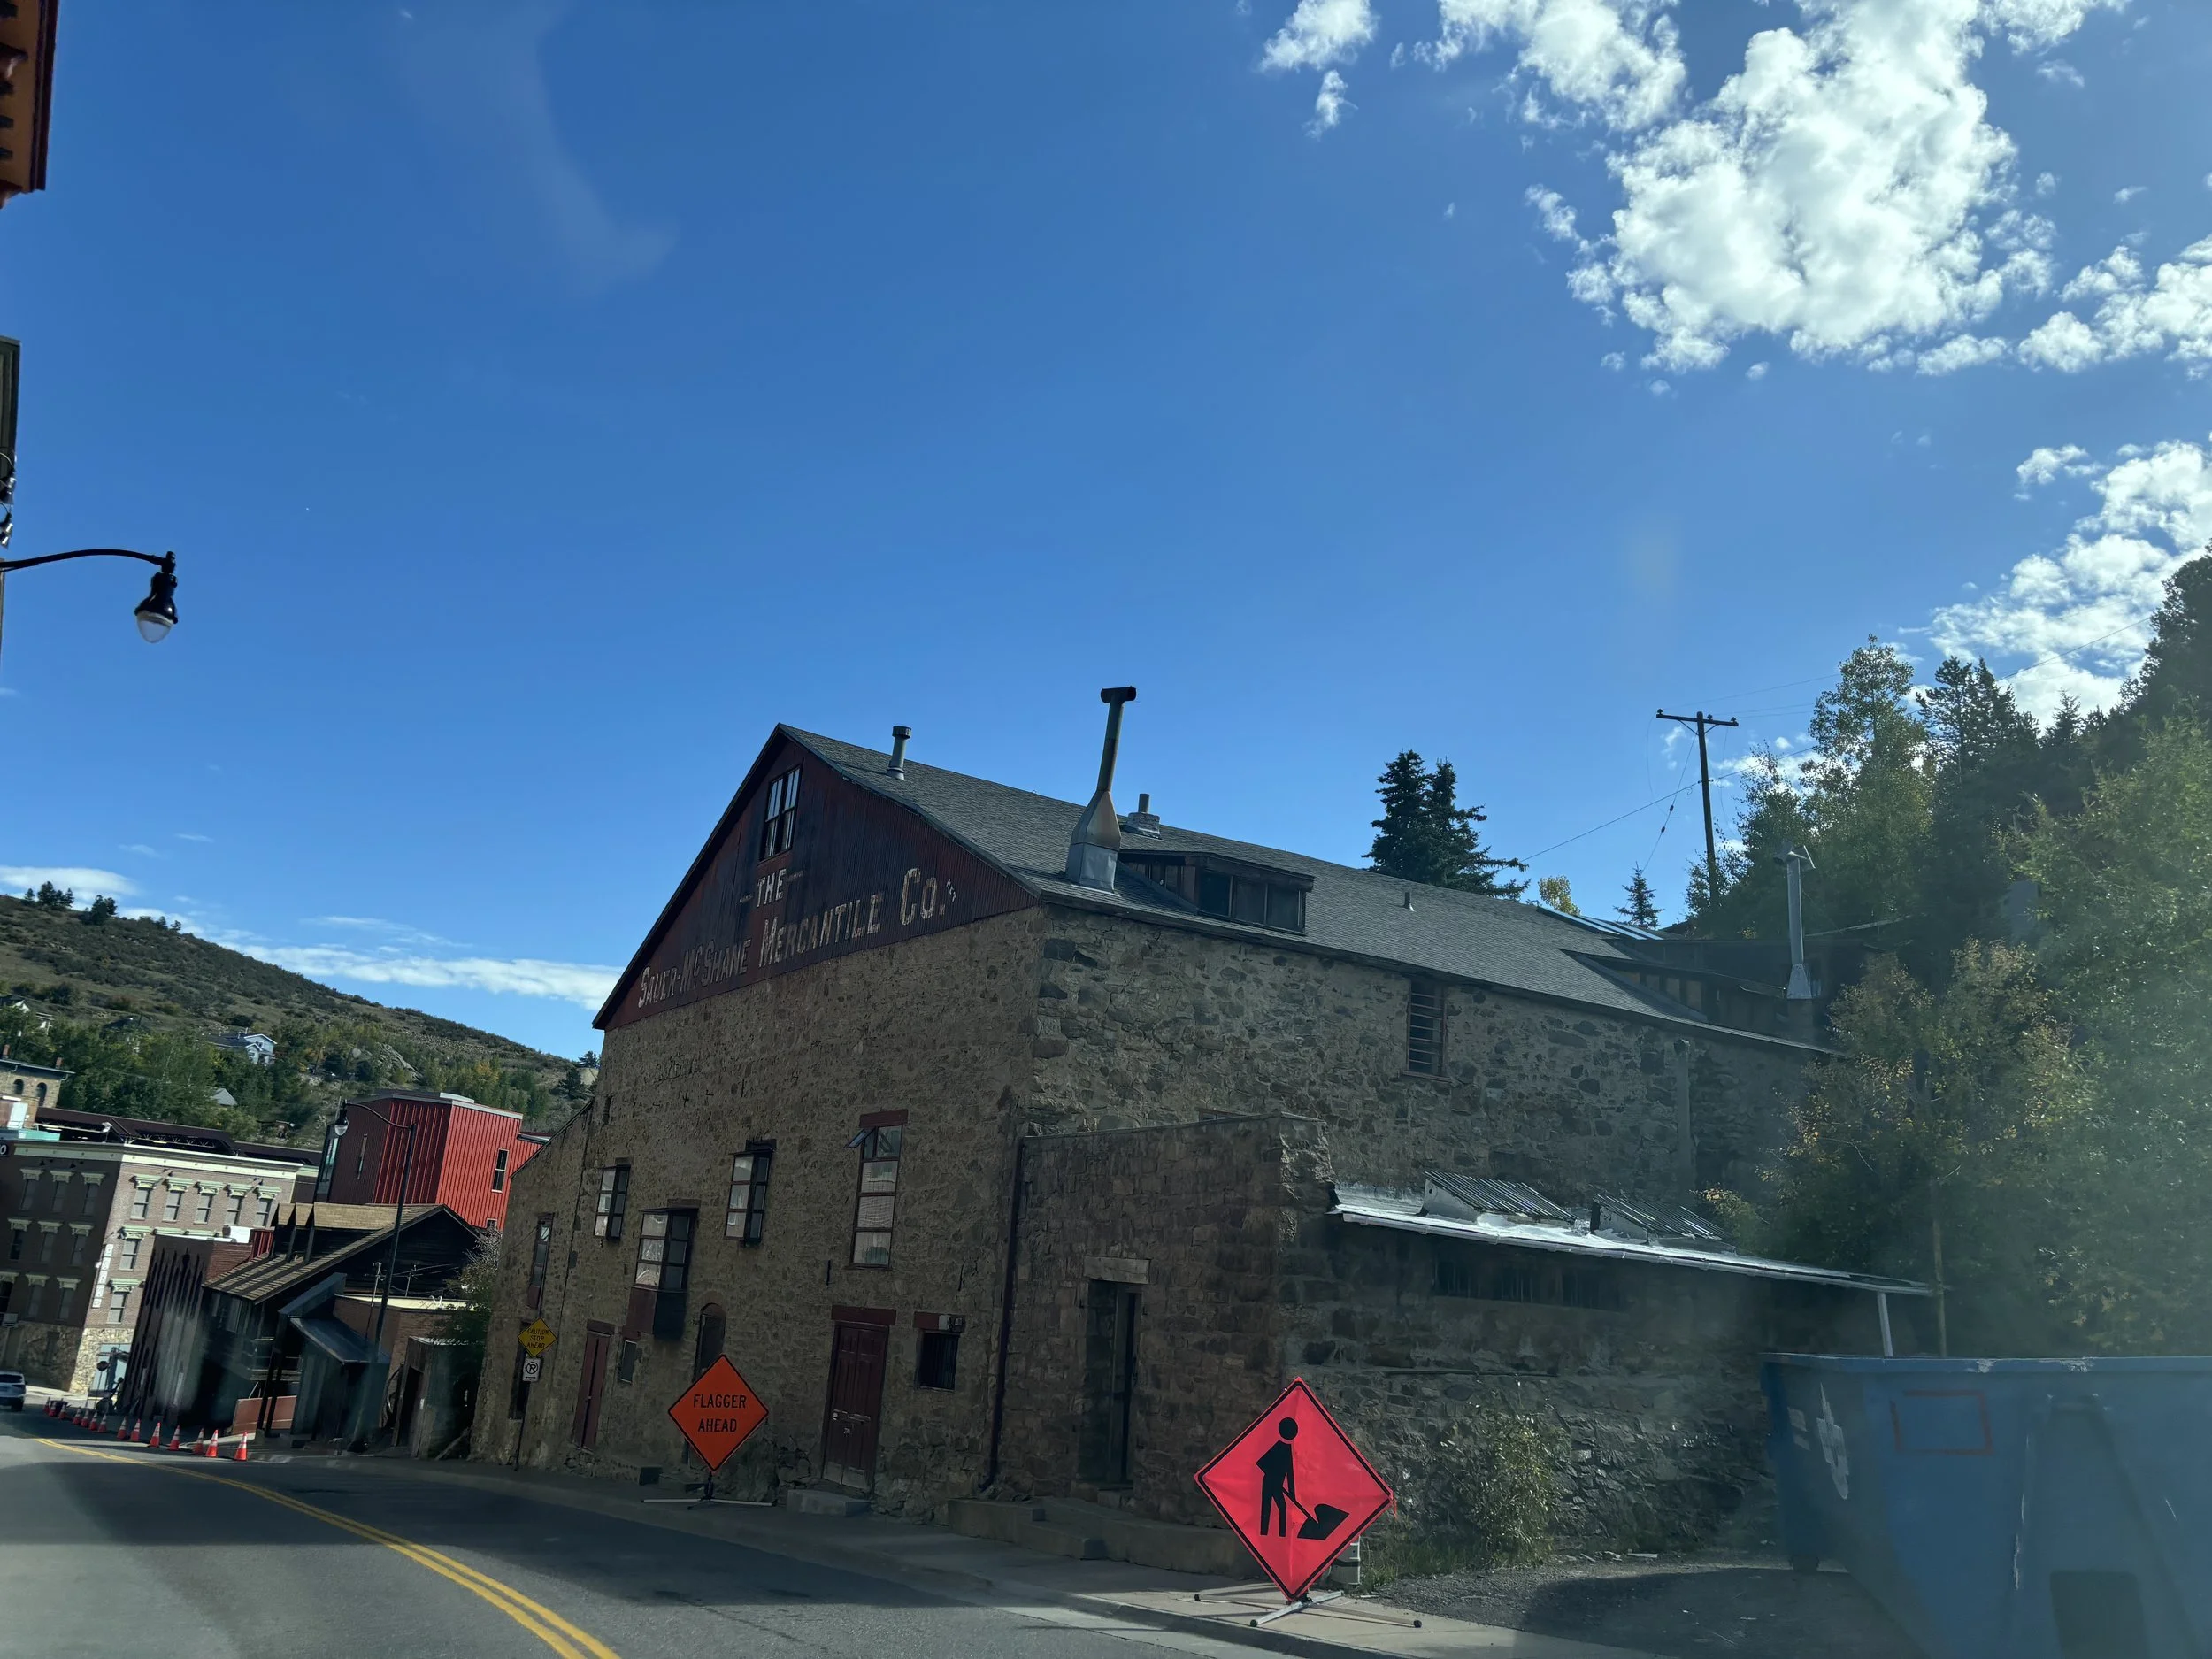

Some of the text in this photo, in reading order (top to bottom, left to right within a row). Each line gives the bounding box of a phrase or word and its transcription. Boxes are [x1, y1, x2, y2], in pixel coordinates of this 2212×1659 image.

[757, 868, 787, 908] THE
[759, 894, 883, 968] MERCANTILE
[693, 1394, 747, 1409] FLAGGER
[697, 1418, 737, 1432] AHEAD
